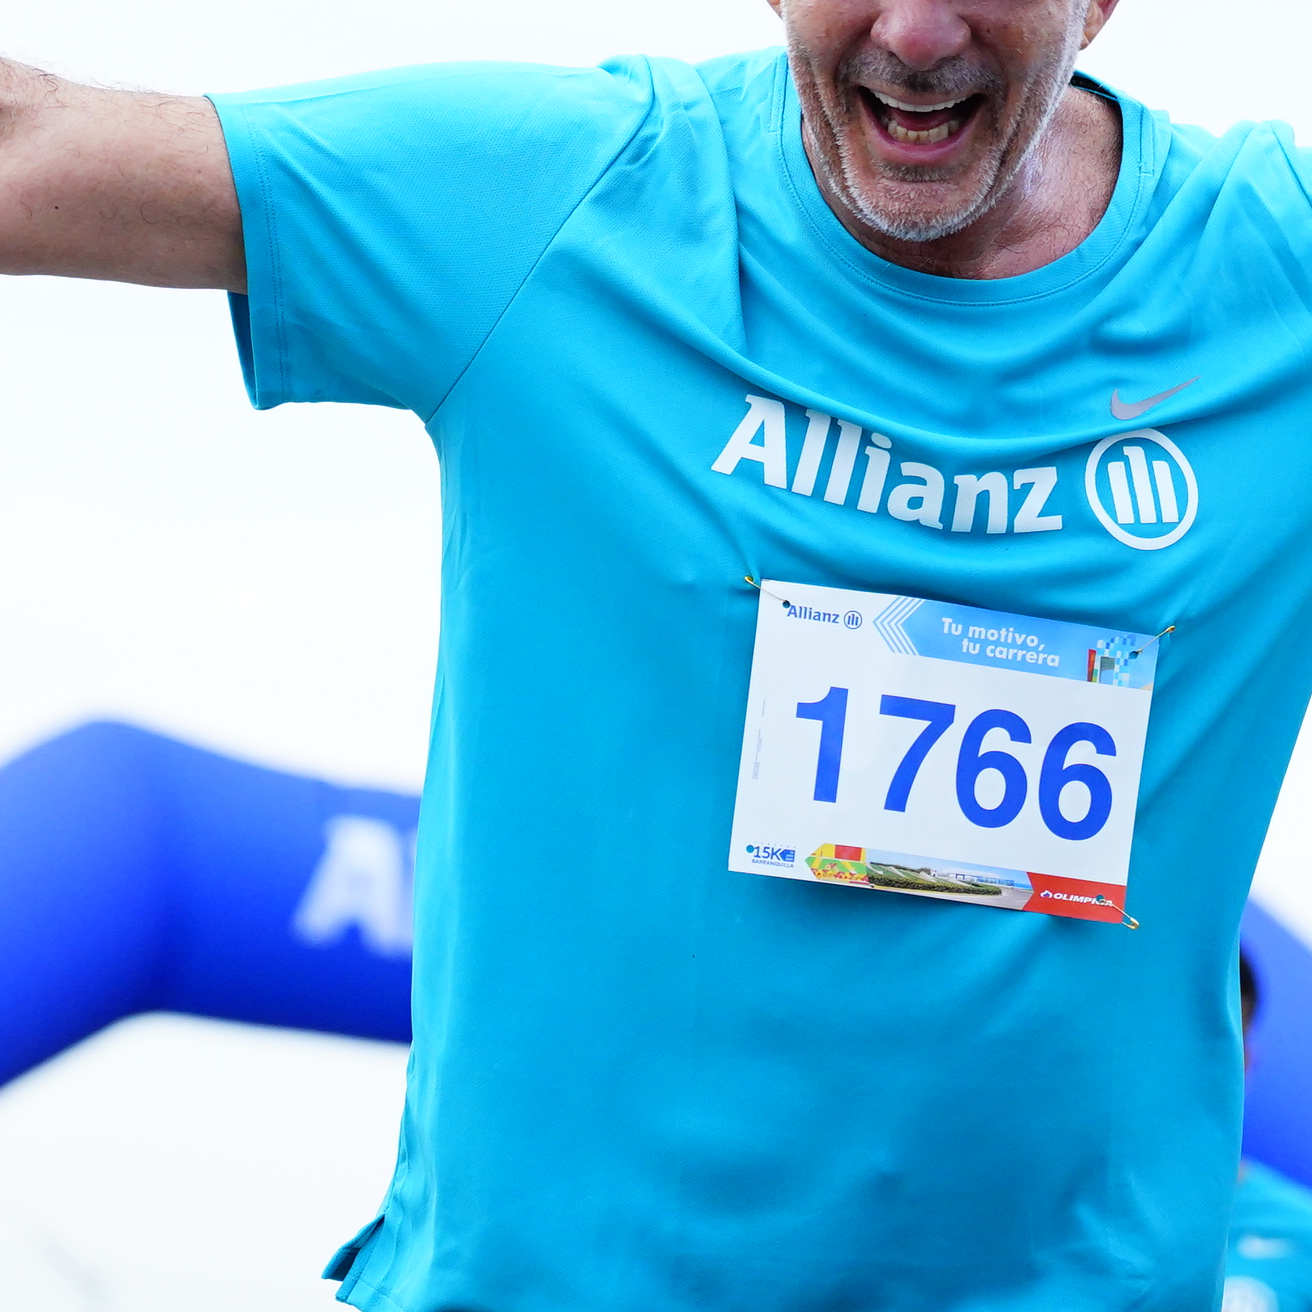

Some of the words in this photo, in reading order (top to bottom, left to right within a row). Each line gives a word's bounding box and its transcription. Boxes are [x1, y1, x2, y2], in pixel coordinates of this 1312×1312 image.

[711, 394, 1063, 534] Allianz
[787, 605, 840, 624] Allianz
[942, 617, 963, 636] Tu
[968, 625, 1045, 651] motivo,
[962, 638, 980, 654] tu
[986, 645, 1060, 667] carrera
[796, 686, 1117, 841] 1766
[753, 846, 782, 861] 15K
